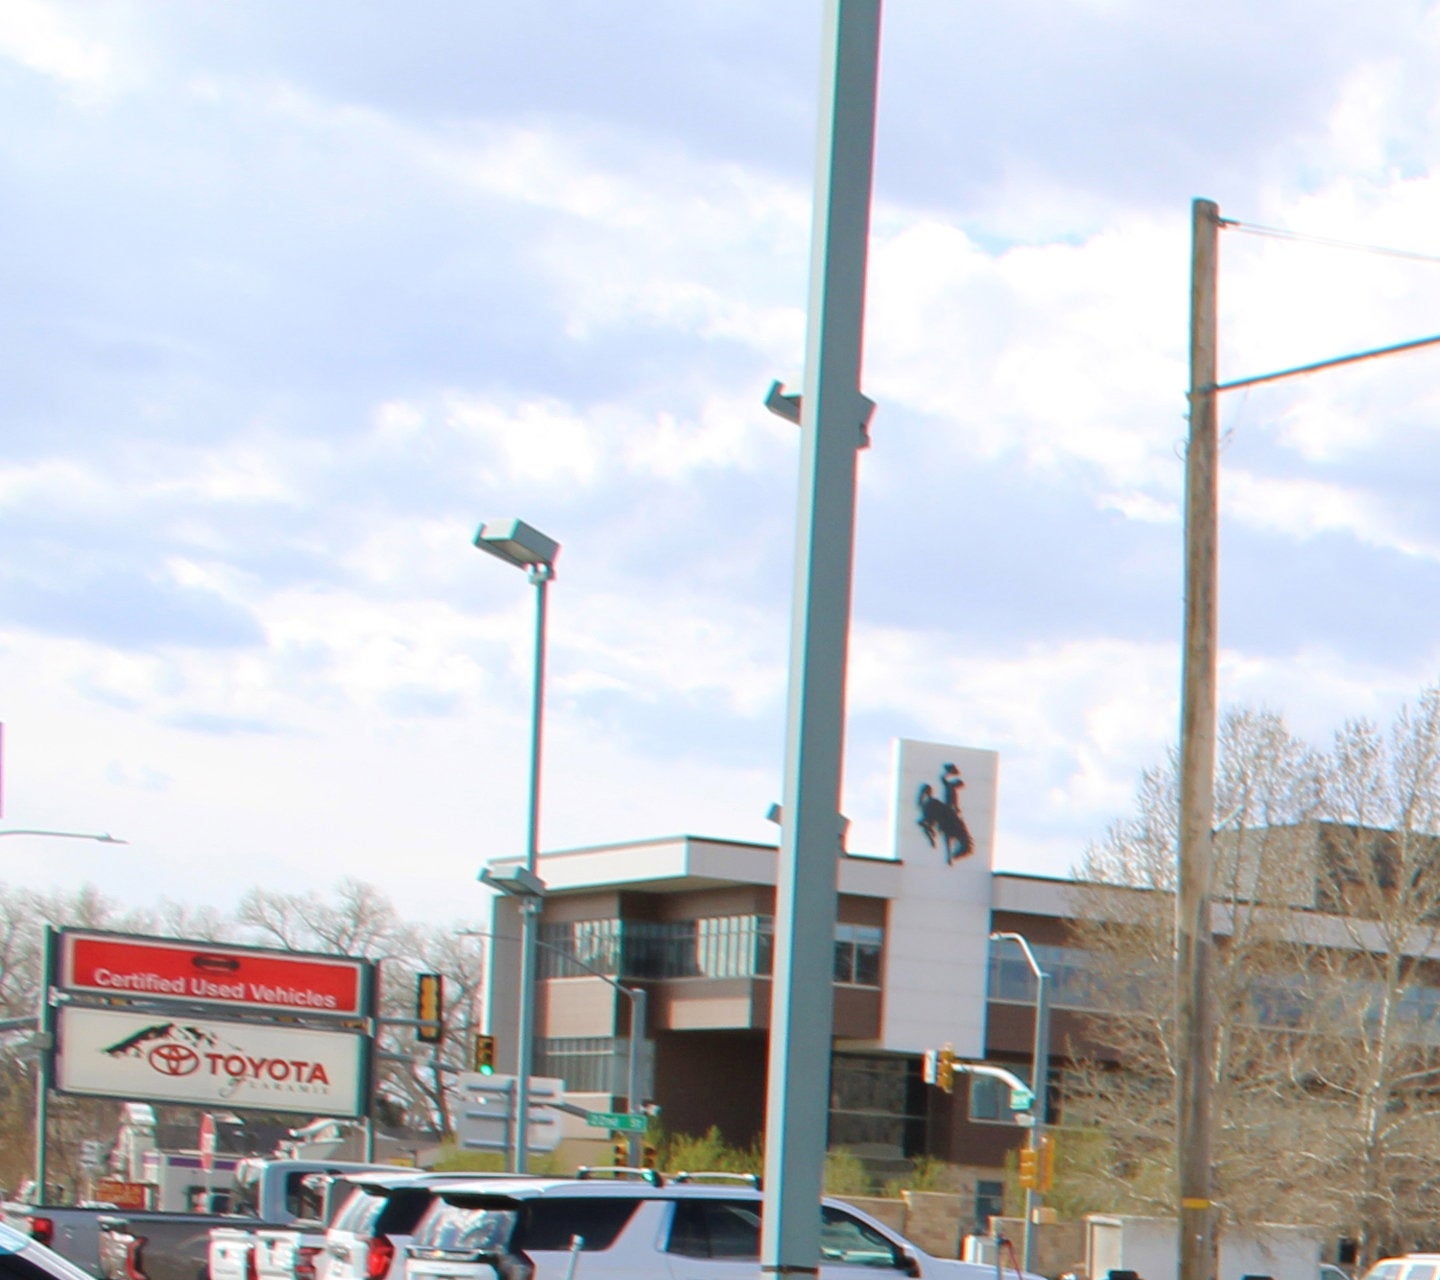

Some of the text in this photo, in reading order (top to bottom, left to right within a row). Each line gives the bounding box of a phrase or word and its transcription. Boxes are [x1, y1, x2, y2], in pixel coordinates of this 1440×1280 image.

[95, 968, 337, 1008] Certified Used Vehicles
[203, 1053, 330, 1085] TOYOTA
